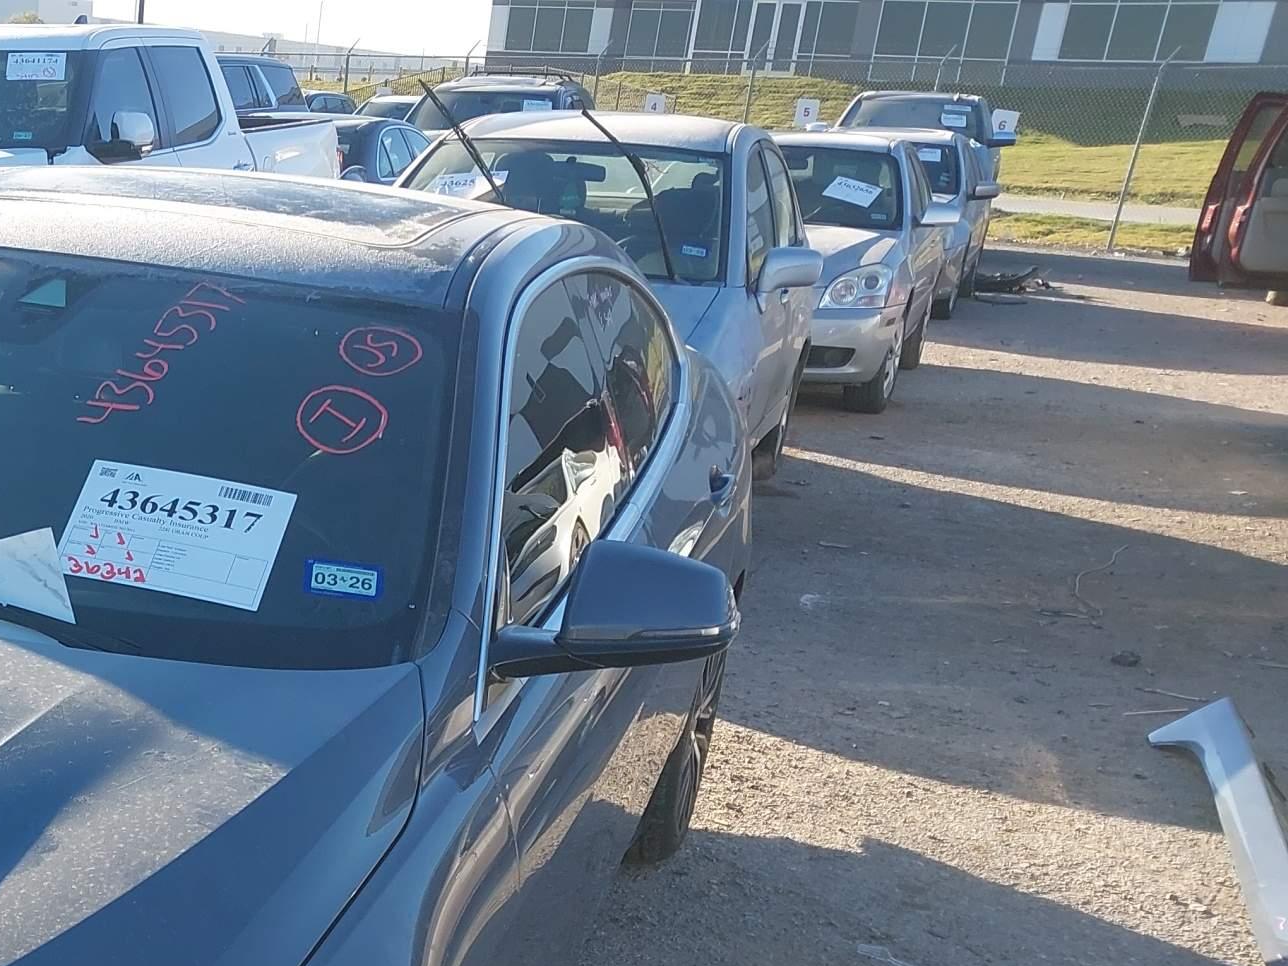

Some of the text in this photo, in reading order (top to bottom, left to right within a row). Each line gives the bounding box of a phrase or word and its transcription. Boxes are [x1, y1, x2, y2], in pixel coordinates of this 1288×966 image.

[650, 102, 657, 111] 4
[803, 107, 811, 117] 5
[998, 120, 1007, 131] 6
[76, 280, 246, 424] 43645317
[83, 505, 209, 532] Progressive Casualty Insurance
[100, 488, 264, 533] 43645317
[314, 571, 373, 591] 03 26
